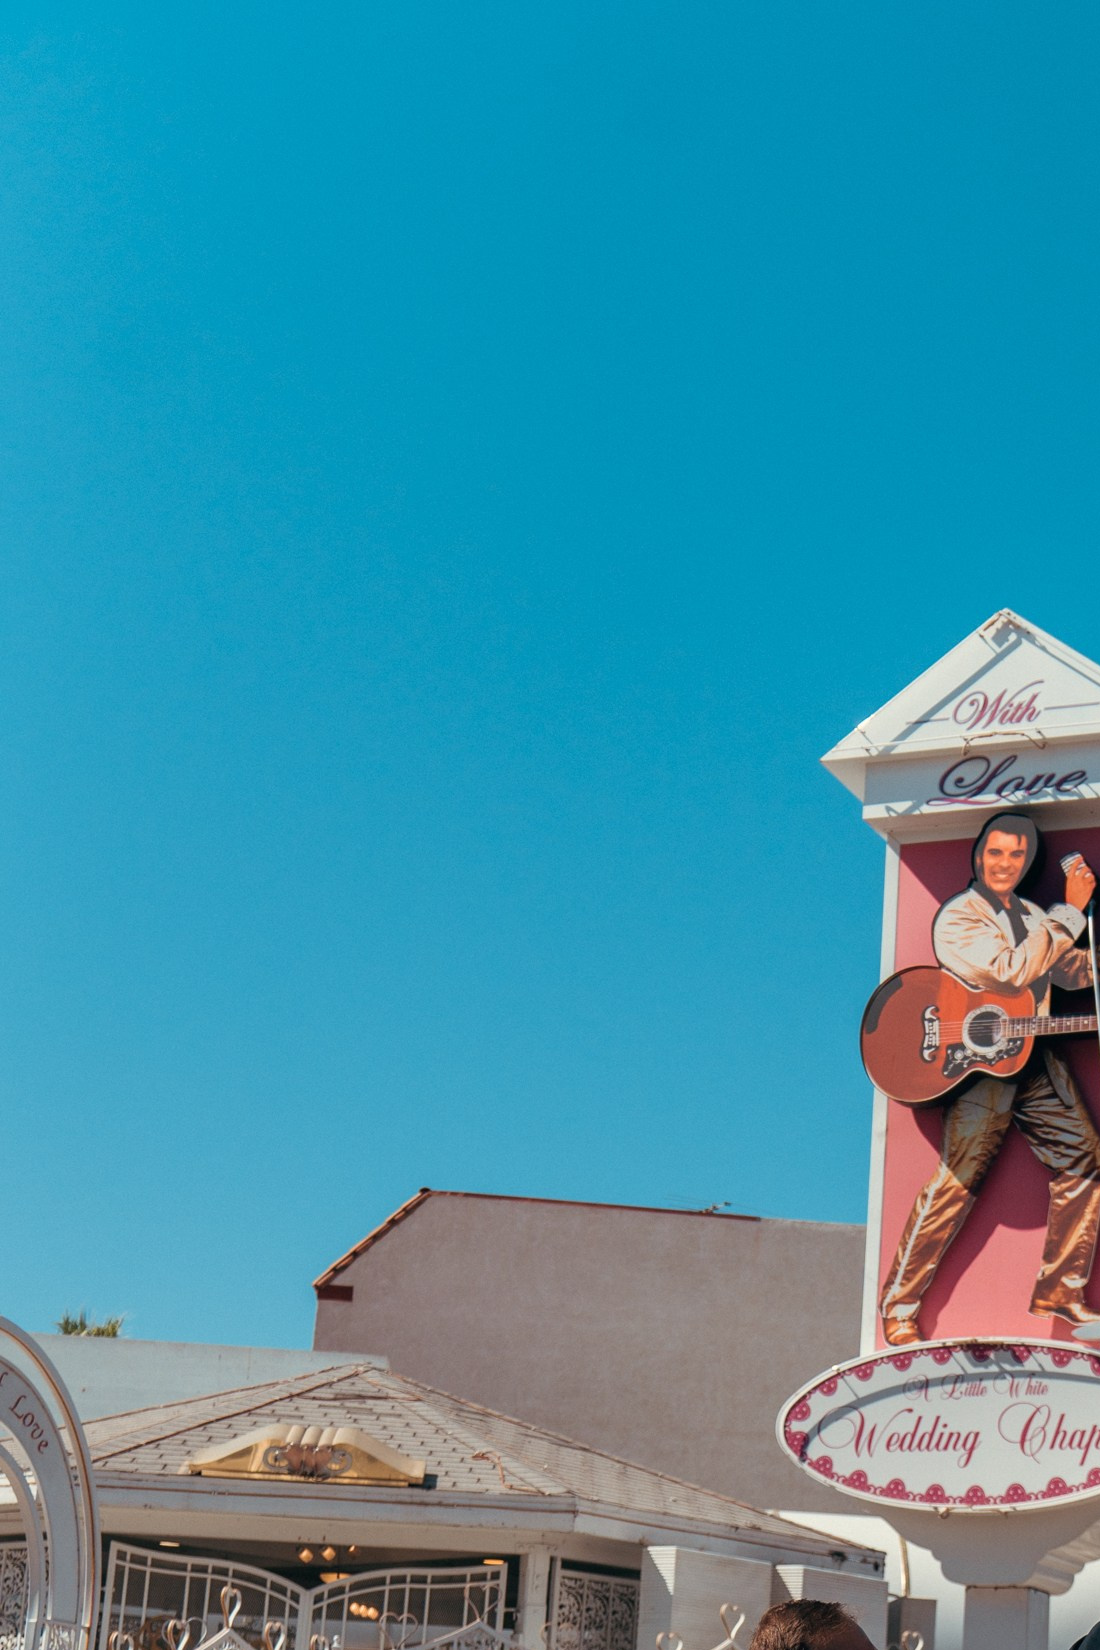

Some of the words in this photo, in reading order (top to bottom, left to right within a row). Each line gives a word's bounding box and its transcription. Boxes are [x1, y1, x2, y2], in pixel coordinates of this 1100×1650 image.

[952, 680, 1044, 731] With
[926, 755, 1088, 807] Love
[902, 1374, 930, 1402] A
[941, 1374, 988, 1399] Little
[993, 1373, 1049, 1398] White
[8, 1395, 49, 1455] Love
[818, 1406, 981, 1469] Wedding
